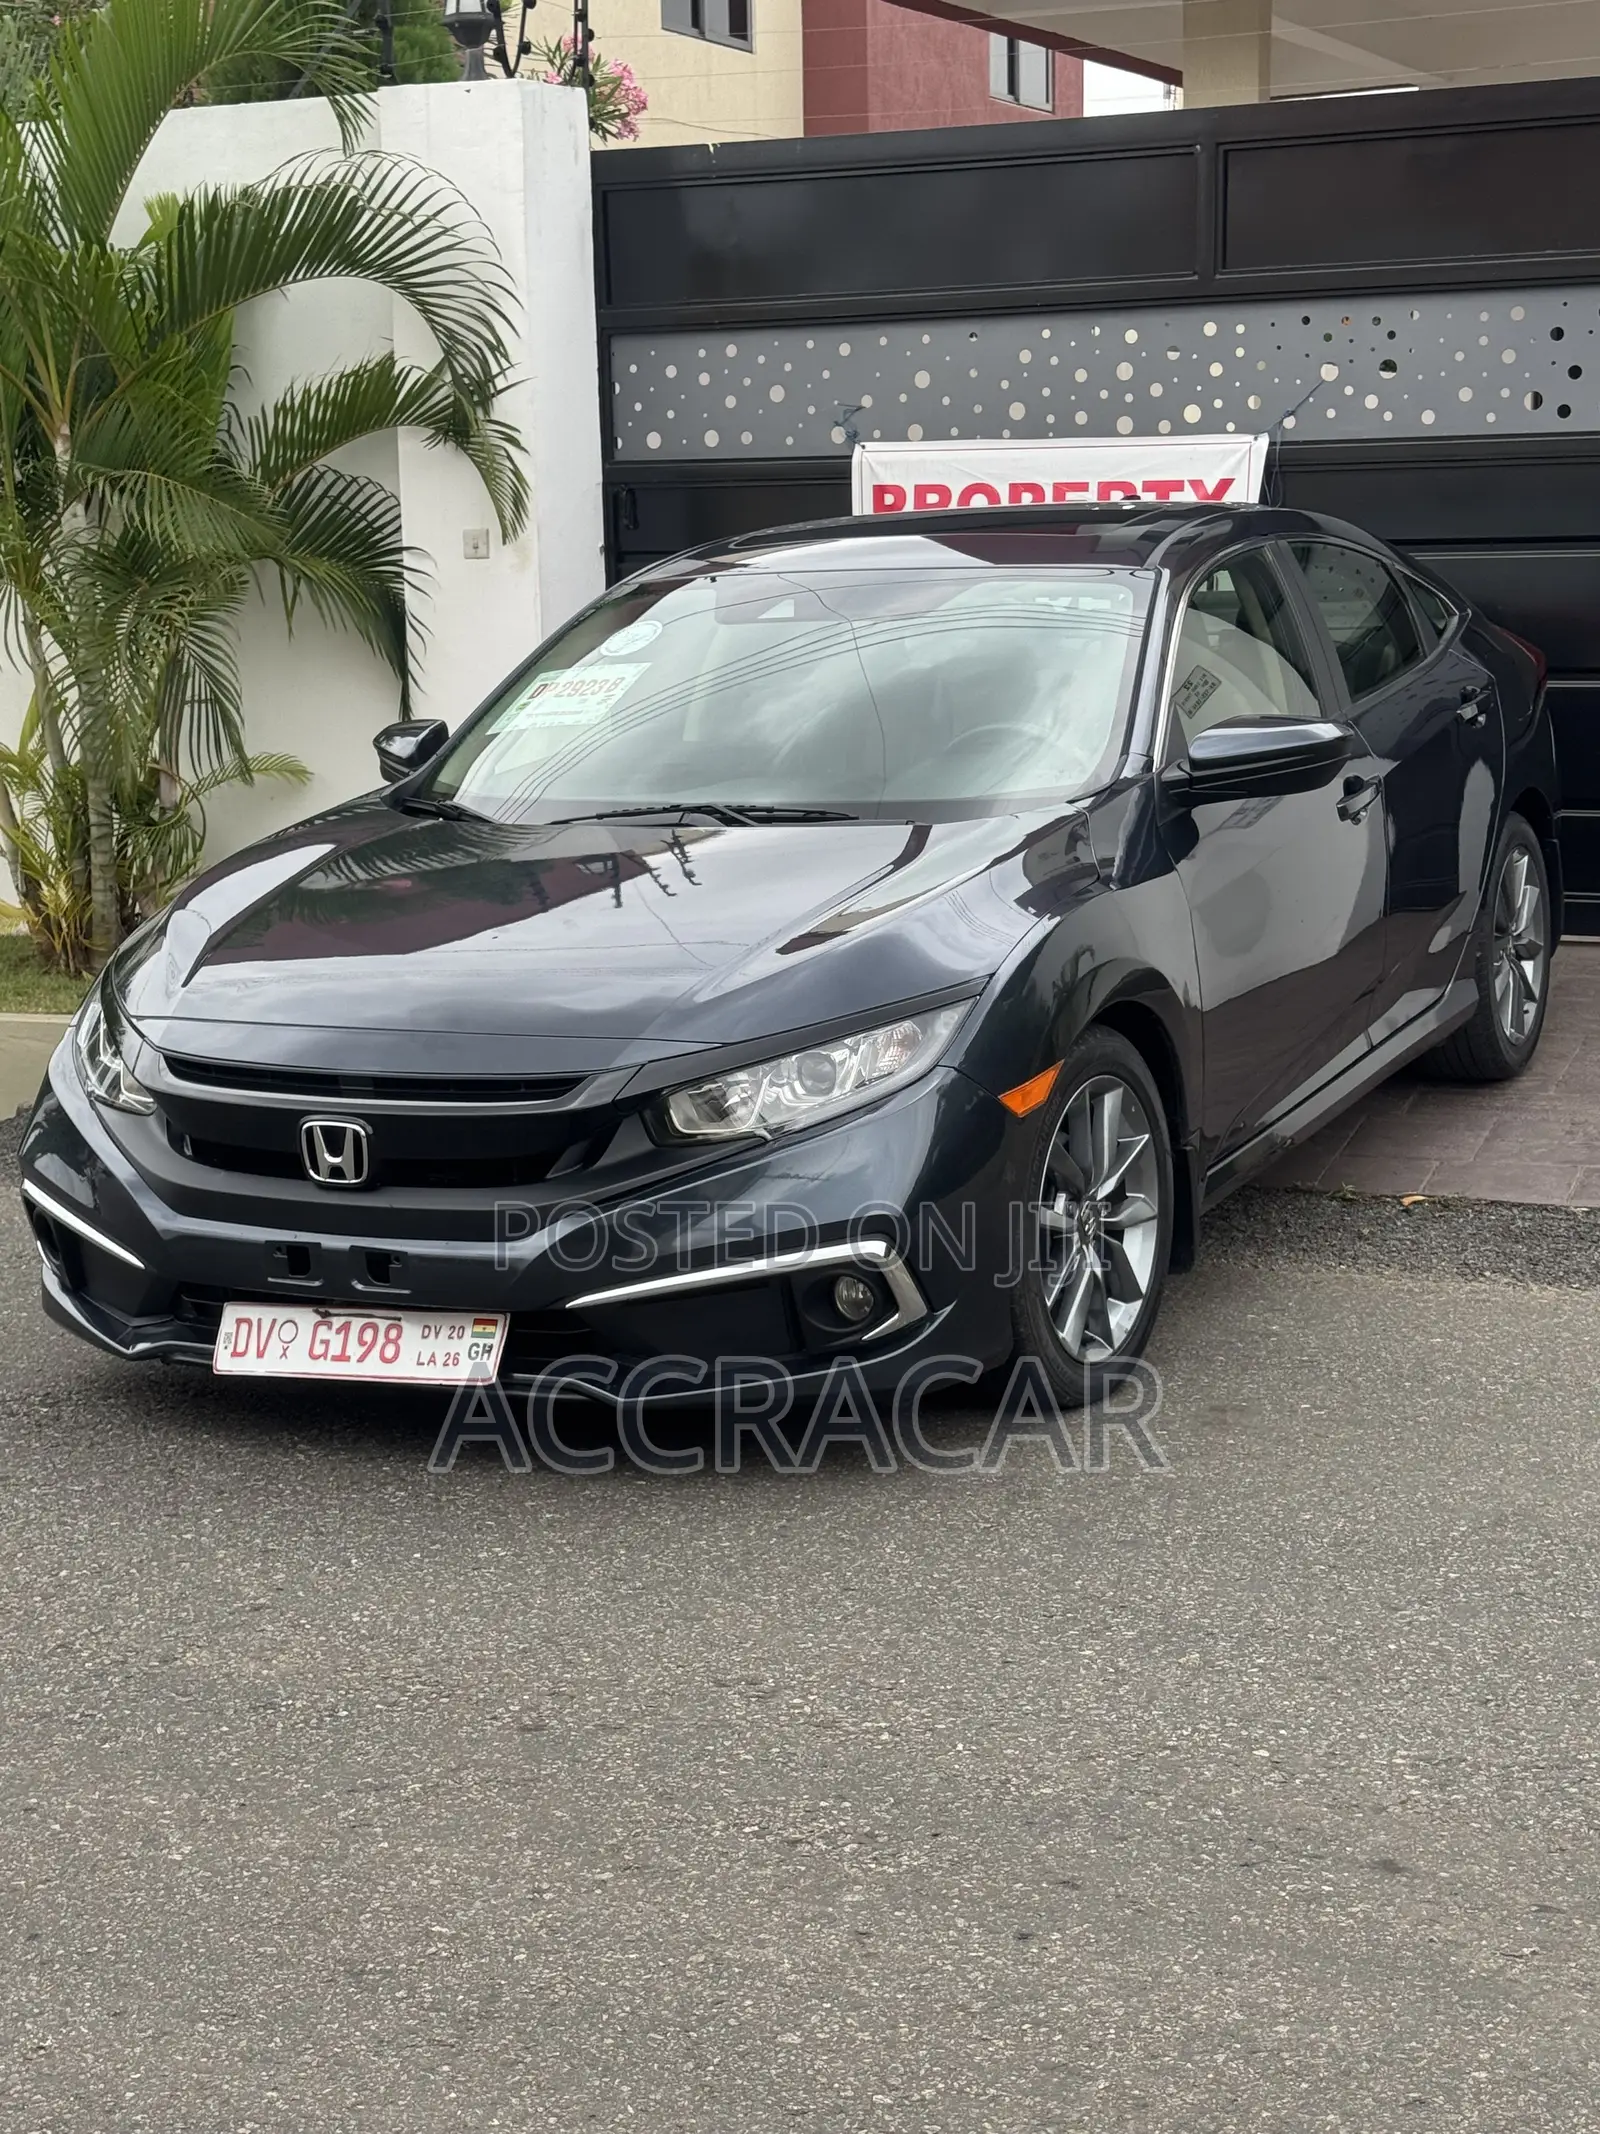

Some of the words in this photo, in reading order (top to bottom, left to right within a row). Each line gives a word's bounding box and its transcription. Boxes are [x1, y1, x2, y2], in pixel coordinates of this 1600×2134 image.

[230, 1317, 277, 1359] DV
[308, 1319, 403, 1365] G198
[421, 1324, 442, 1340] DV
[448, 1324, 466, 1340] 20
[416, 1350, 437, 1366] LA
[443, 1351, 461, 1367] 26
[468, 1342, 494, 1361] GH
